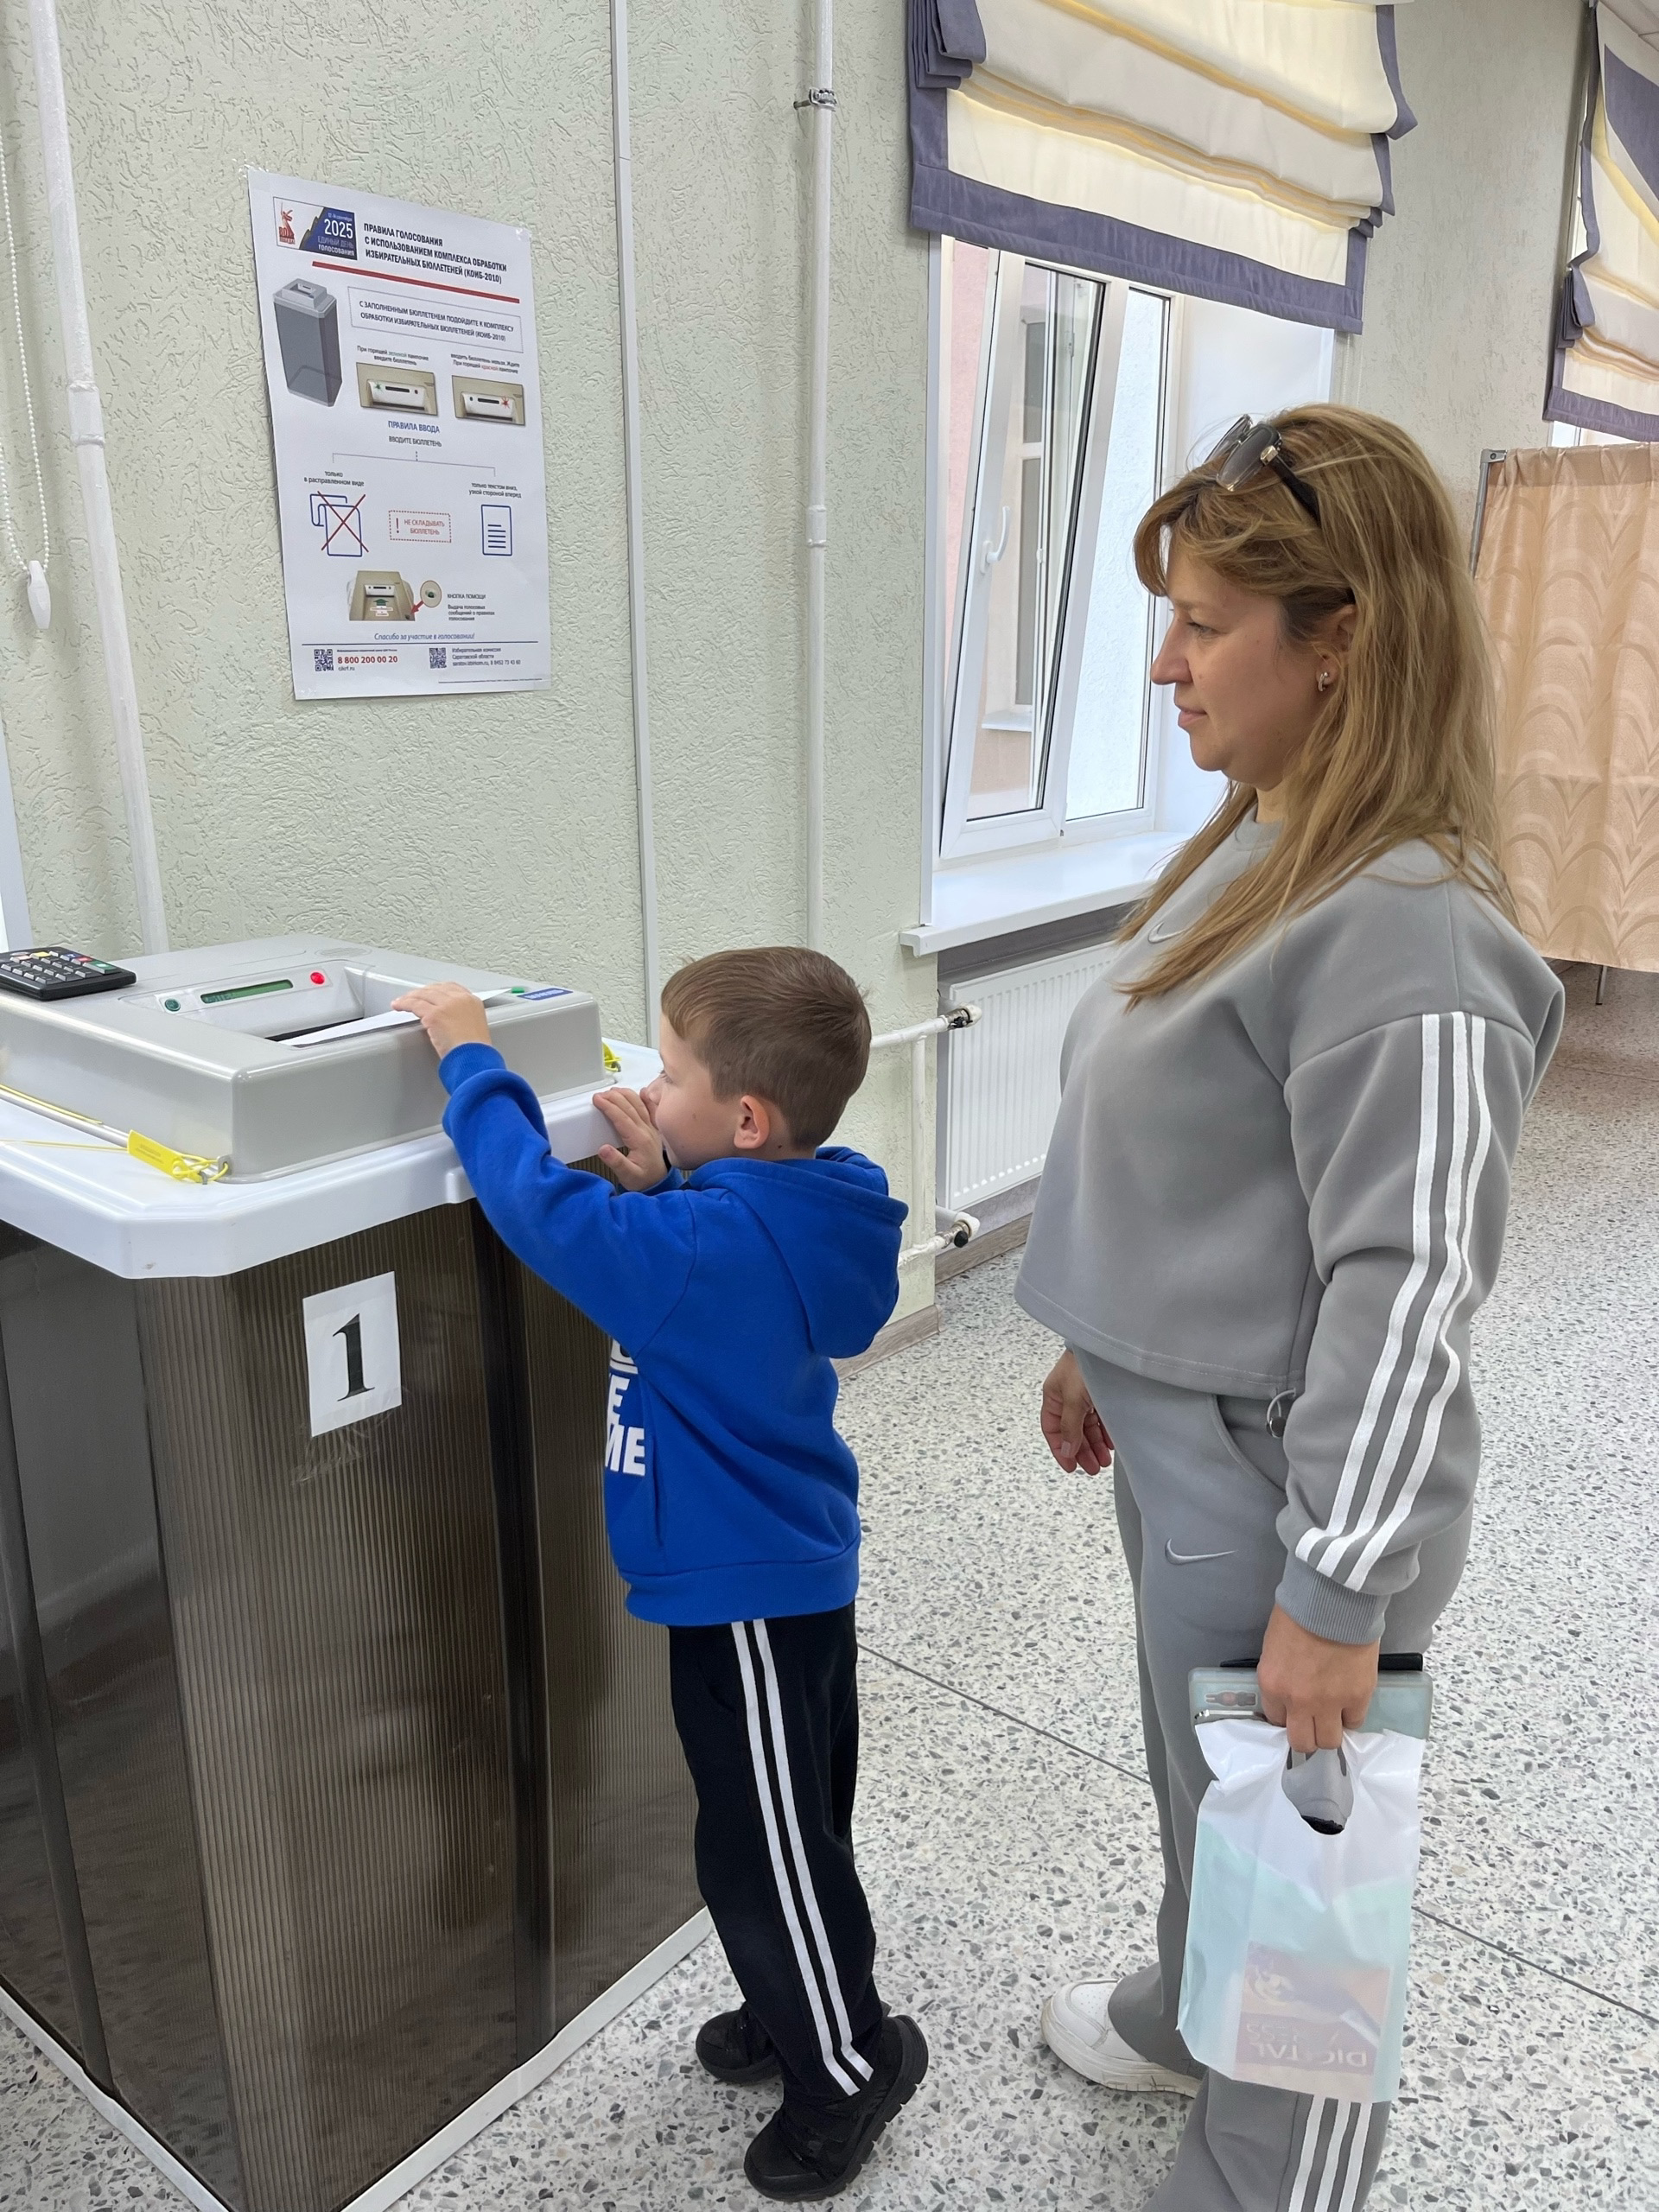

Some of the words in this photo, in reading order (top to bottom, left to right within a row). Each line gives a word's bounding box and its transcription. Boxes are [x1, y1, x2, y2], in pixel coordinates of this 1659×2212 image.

[324, 218, 353, 239] 2025
[364, 223, 395, 238] ПРАВИЛА
[395, 230, 443, 247] ГОЛОСОВАНИЯ
[317, 235, 340, 246] ЕДИНЫЙ
[340, 240, 354, 249] ДЕНЬ
[365, 236, 370, 245] С
[371, 238, 433, 257] ИСПОЛЬЗОВАНИЕМ
[434, 251, 472, 266] КОМПЛЕКСА
[472, 258, 507, 272] ОБРАБОТКИ
[365, 249, 421, 267] ИЗБИРАТЕЛЬНЫХ
[422, 261, 463, 276] БЮЛЛЕТЕНЕЙ
[464, 269, 502, 285] (КОИБ-2010)
[360, 312, 394, 324] ОБРАБОТКИ
[394, 318, 439, 331] ИЗБИРАТЕЛЬНЫХ
[440, 325, 474, 337] БЮЛЛЕТЕНЕЙ
[475, 331, 506, 342] (КОИБ-2010)
[364, 302, 408, 315] ЗАПОЛНЕННЫМ
[409, 308, 446, 321] БЮЛЛЕТЕНЕМ
[446, 315, 479, 327] ПОДОЙДИТЕ
[484, 321, 514, 332] КОМПЛЕКСУ
[357, 345, 367, 353] При
[388, 420, 418, 431] ПРАВИЛА
[419, 424, 441, 434] ВВОДА
[389, 436, 412, 445] ВВОДИТЕ
[413, 438, 442, 447] БЮЛЛЕТЕНЬ
[438, 632, 475, 640] голосовании!
[333, 1313, 376, 1402] 1
[607, 1372, 631, 1428] E
